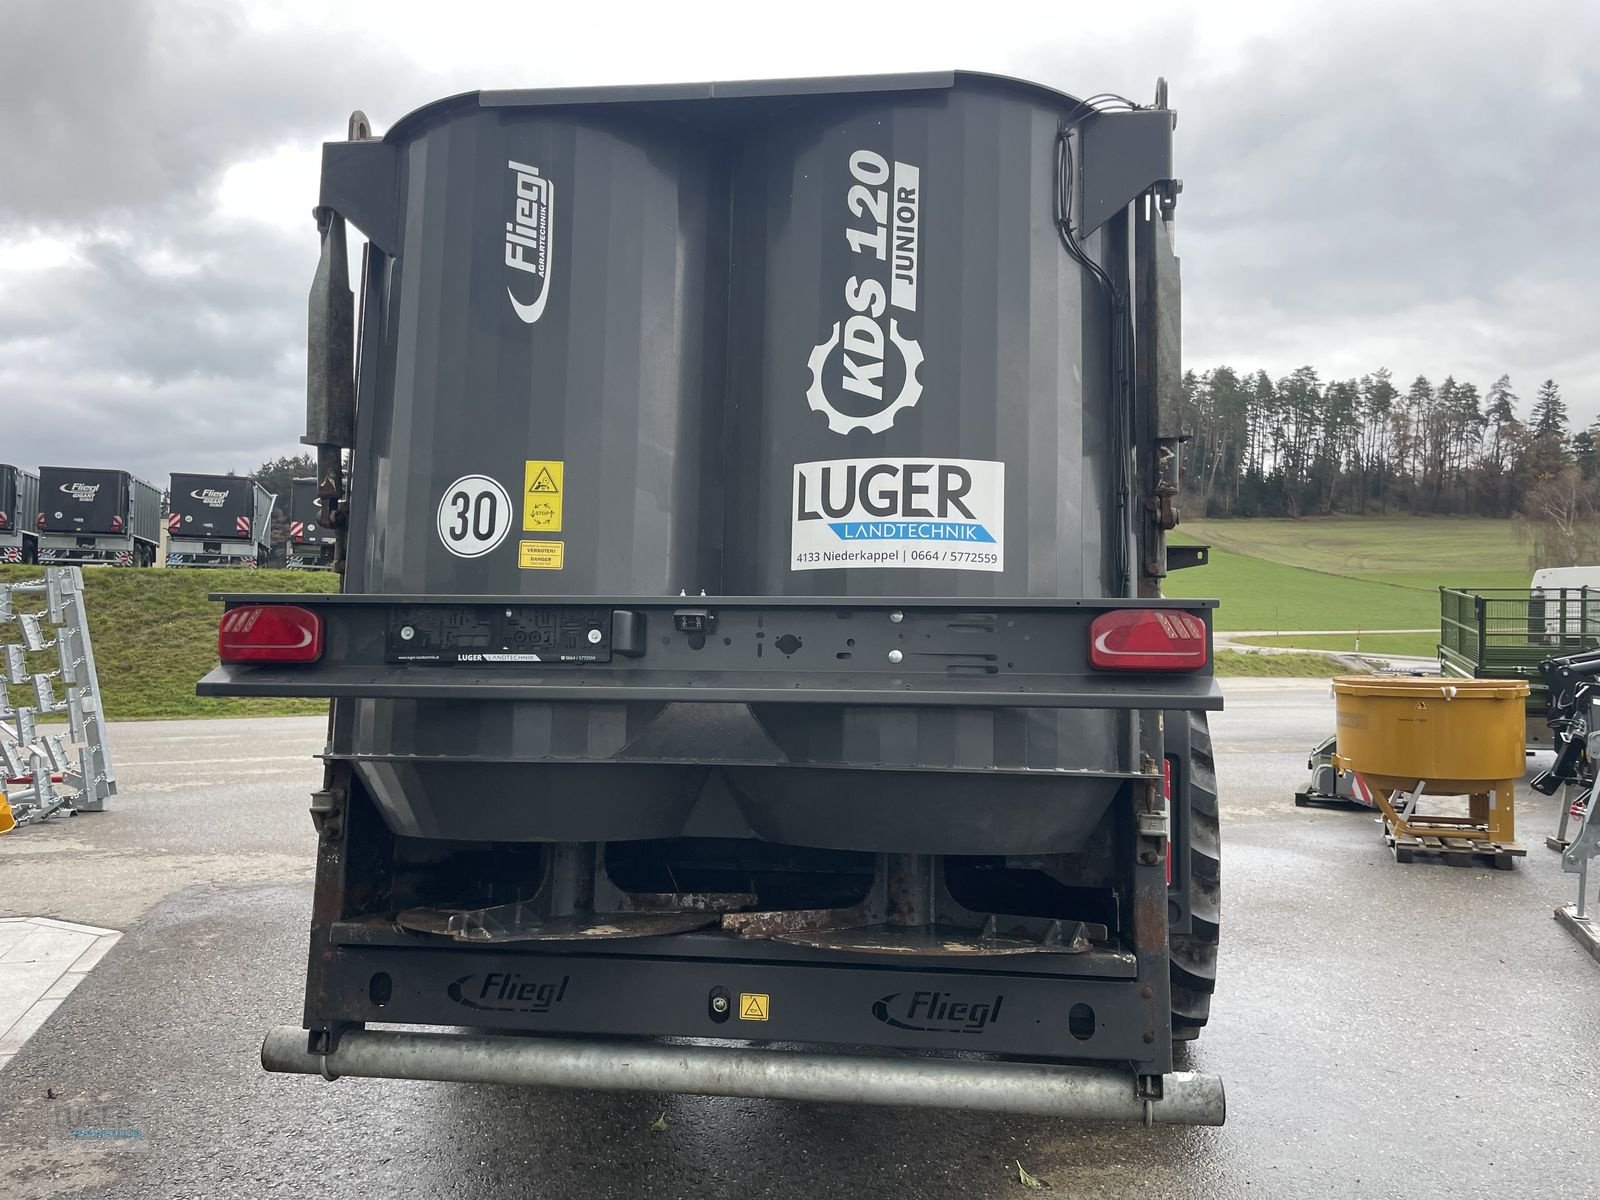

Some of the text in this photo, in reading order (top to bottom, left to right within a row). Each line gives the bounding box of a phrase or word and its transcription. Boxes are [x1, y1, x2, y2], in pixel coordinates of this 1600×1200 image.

[505, 160, 548, 274] Fliegl
[538, 205, 547, 278] AGRARTECHNIK
[894, 186, 916, 285] JUNIOR
[842, 149, 890, 400] KDS 120
[202, 489, 230, 498] Fliegl
[449, 490, 497, 542] 30
[797, 464, 977, 521] LUGER
[796, 551, 820, 563] 4133
[823, 550, 899, 563] Niederkappel
[911, 550, 939, 561] 0664
[950, 551, 998, 564] 5772559
[844, 523, 977, 540] LANDTECHNIK
[479, 973, 569, 1012] Fliegl
[907, 991, 1003, 1034] Fliegl
